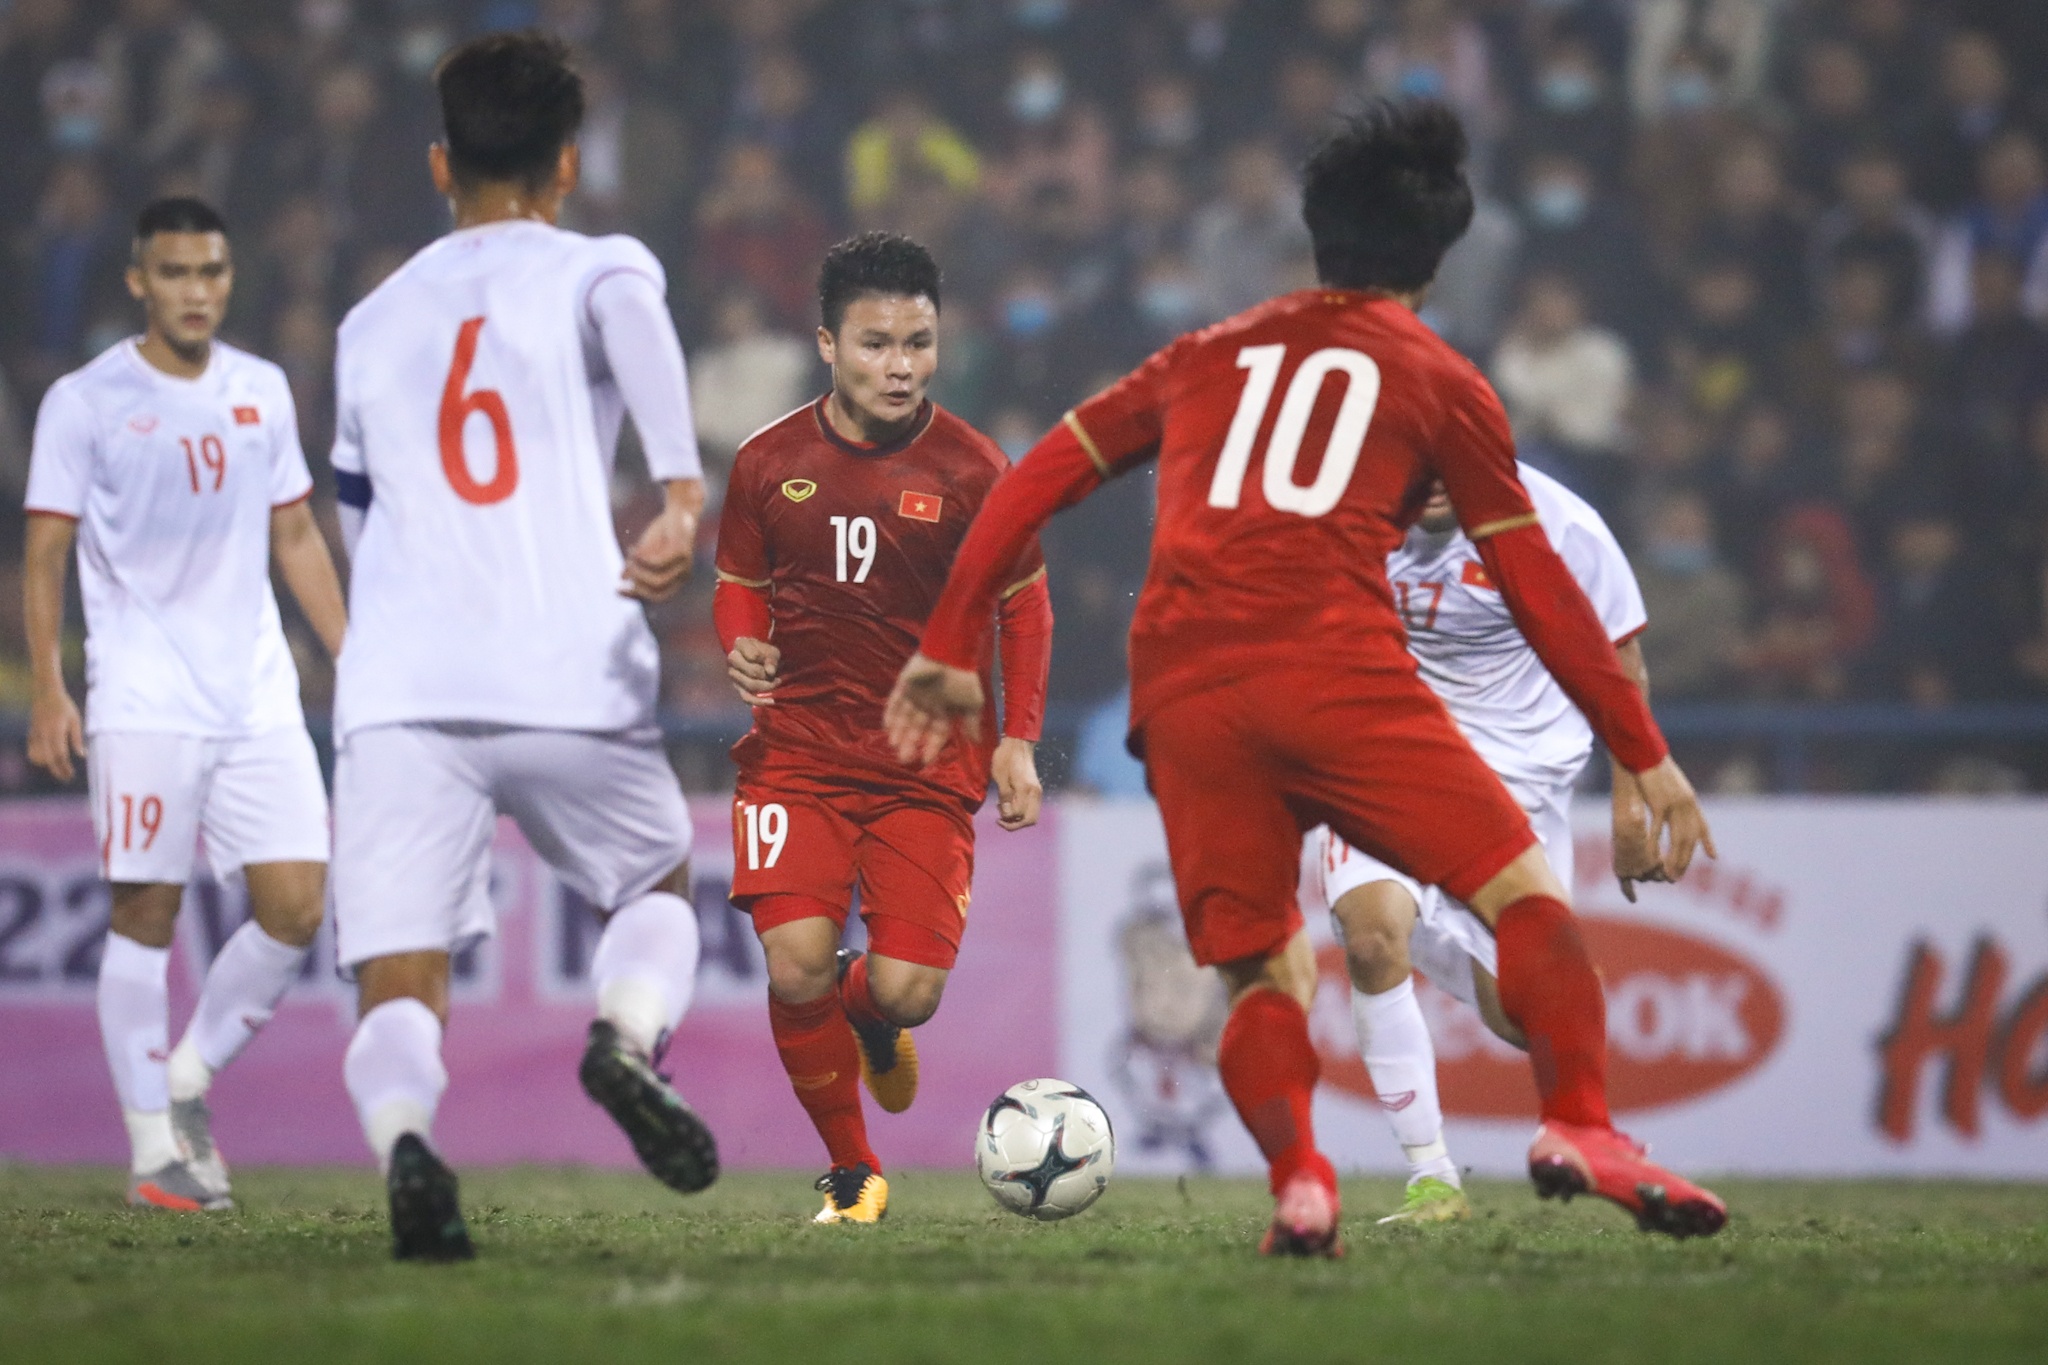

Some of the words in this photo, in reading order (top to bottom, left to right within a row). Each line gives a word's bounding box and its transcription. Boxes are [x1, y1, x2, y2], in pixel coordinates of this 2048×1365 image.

[437, 316, 519, 505] 6
[1208, 344, 1381, 517] 10
[179, 434, 225, 493] 19
[830, 516, 877, 583] 19
[1395, 582, 1444, 630] 17
[121, 794, 163, 852] 19
[744, 803, 788, 870] 19
